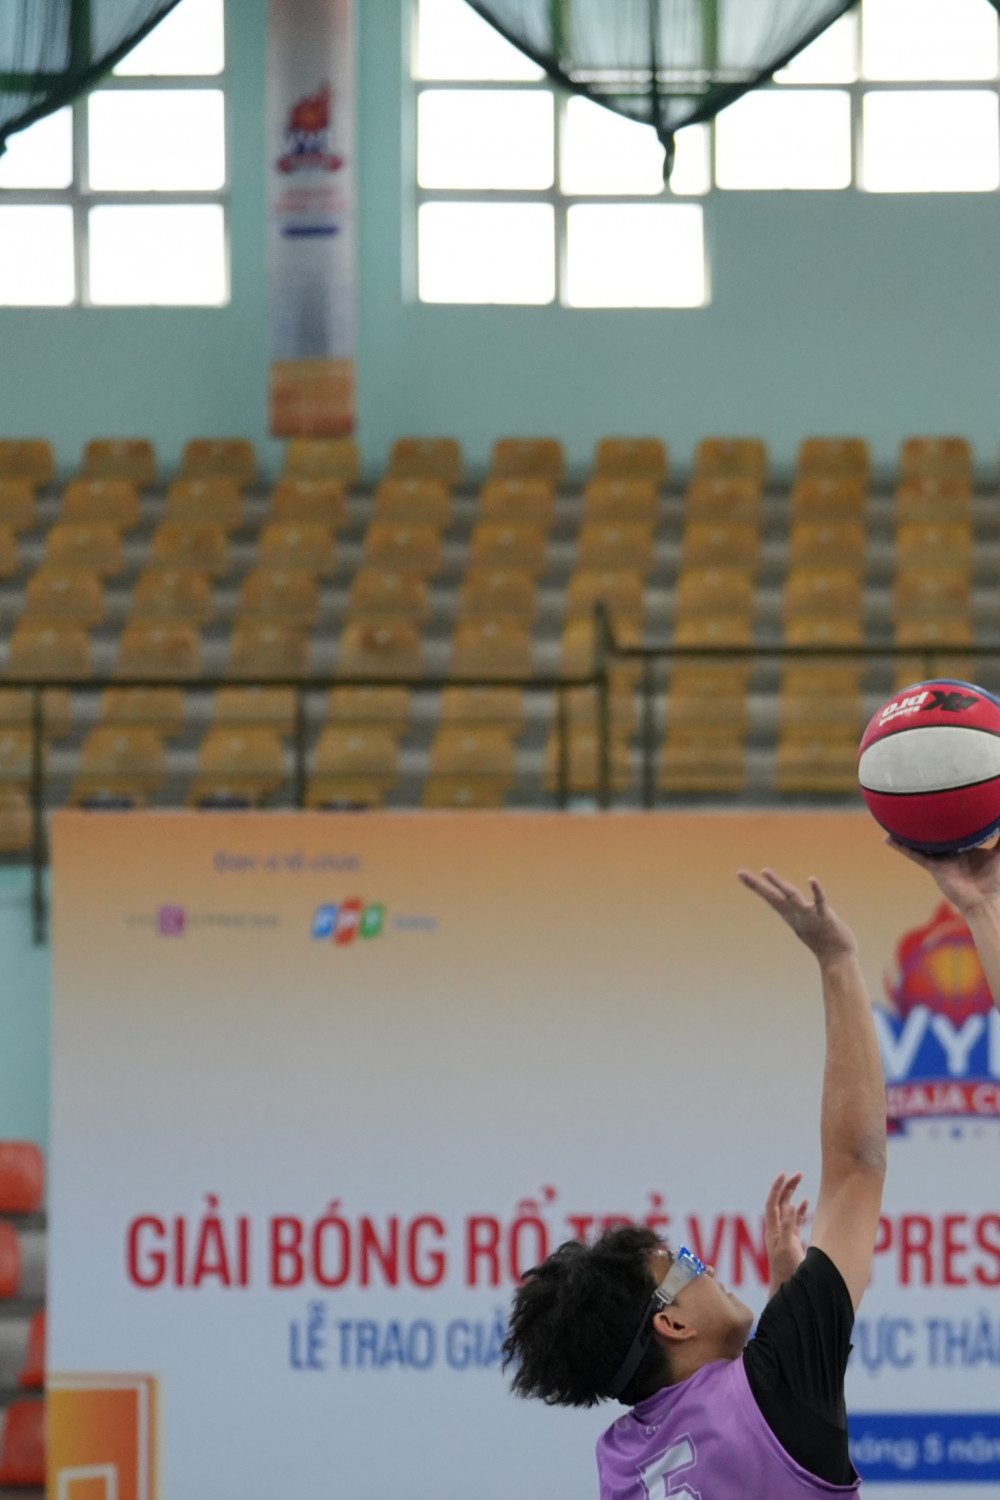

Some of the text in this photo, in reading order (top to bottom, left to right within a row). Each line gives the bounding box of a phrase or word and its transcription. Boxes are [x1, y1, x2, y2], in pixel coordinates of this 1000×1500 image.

[126, 1194, 249, 1289] GIẢI
[270, 1198, 447, 1289] BÓNG
[466, 1185, 557, 1289] RỔ
[289, 1302, 325, 1370] LỄ
[339, 1319, 436, 1370] TRAO
[445, 1304, 521, 1370] GIẢ
